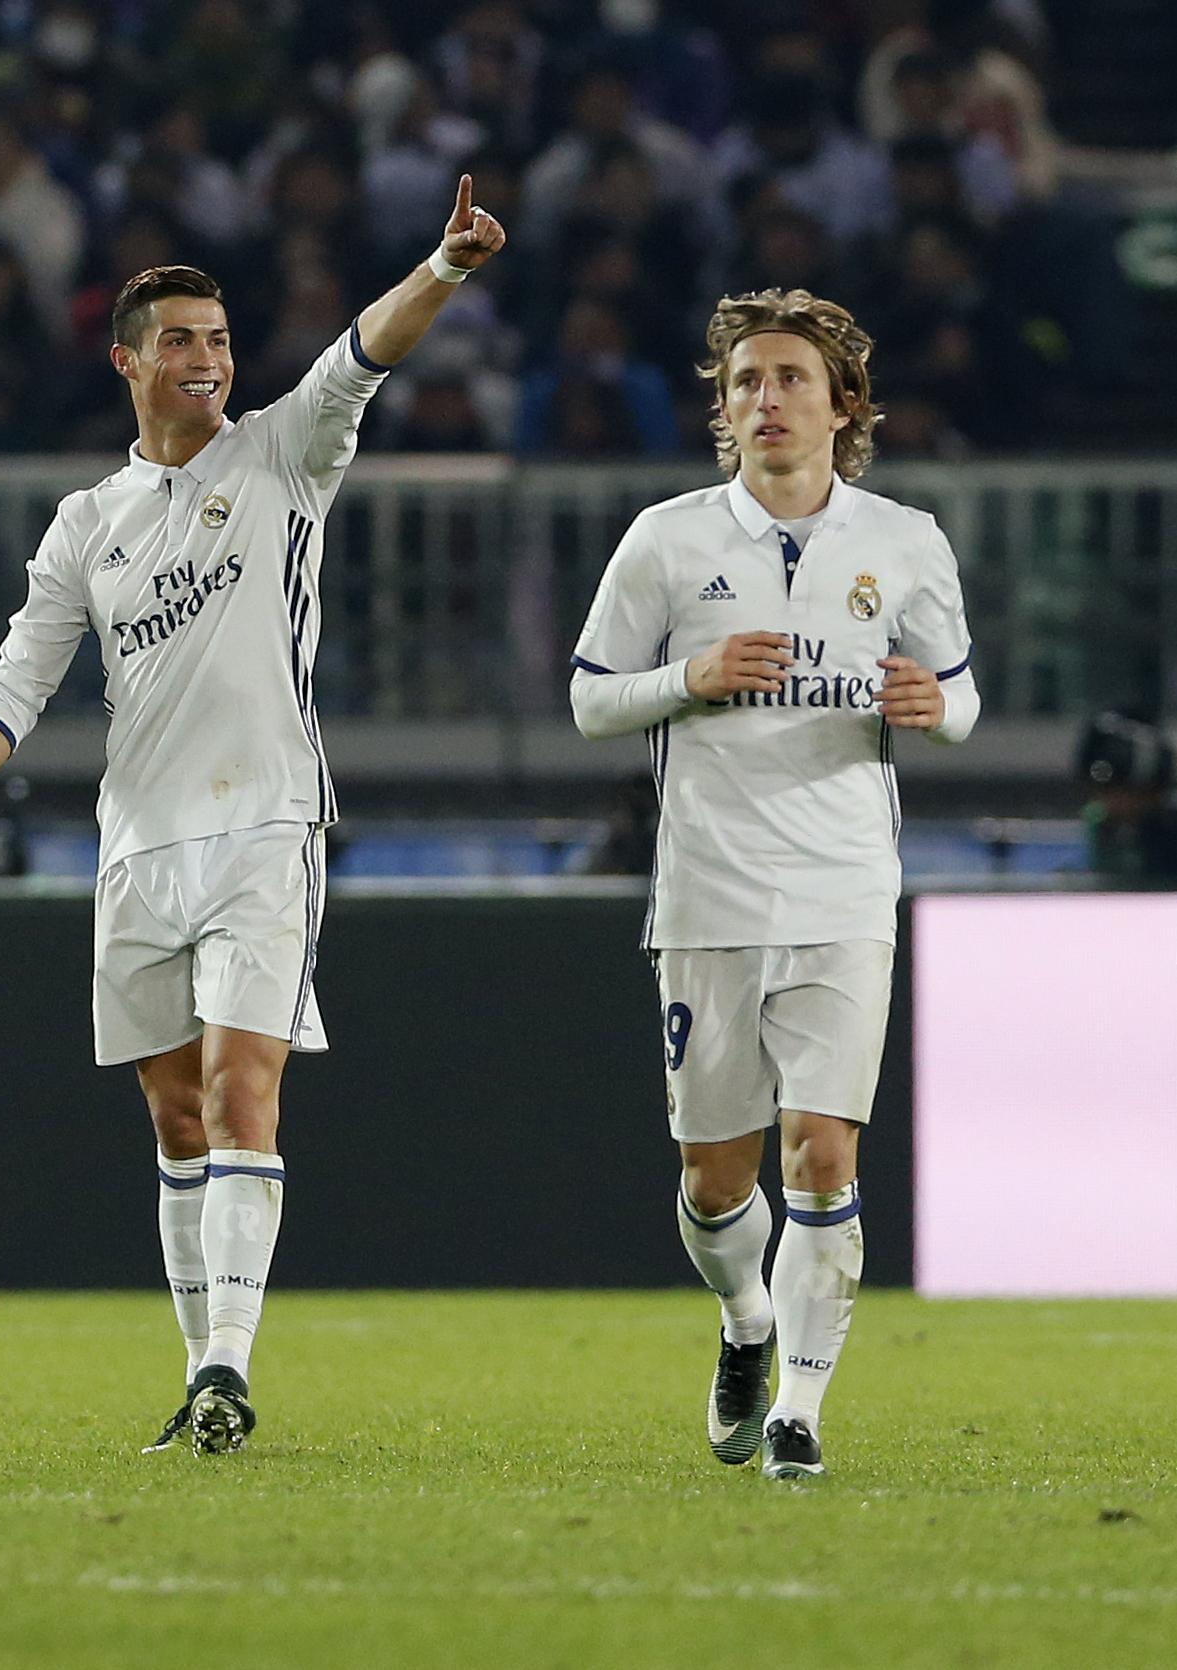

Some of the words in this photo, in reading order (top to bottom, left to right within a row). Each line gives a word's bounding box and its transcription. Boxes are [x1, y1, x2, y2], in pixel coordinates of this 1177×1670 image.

[152, 560, 196, 599] Fly
[697, 590, 738, 601] adidas
[112, 553, 243, 657] Emirates
[778, 632, 826, 668] ly
